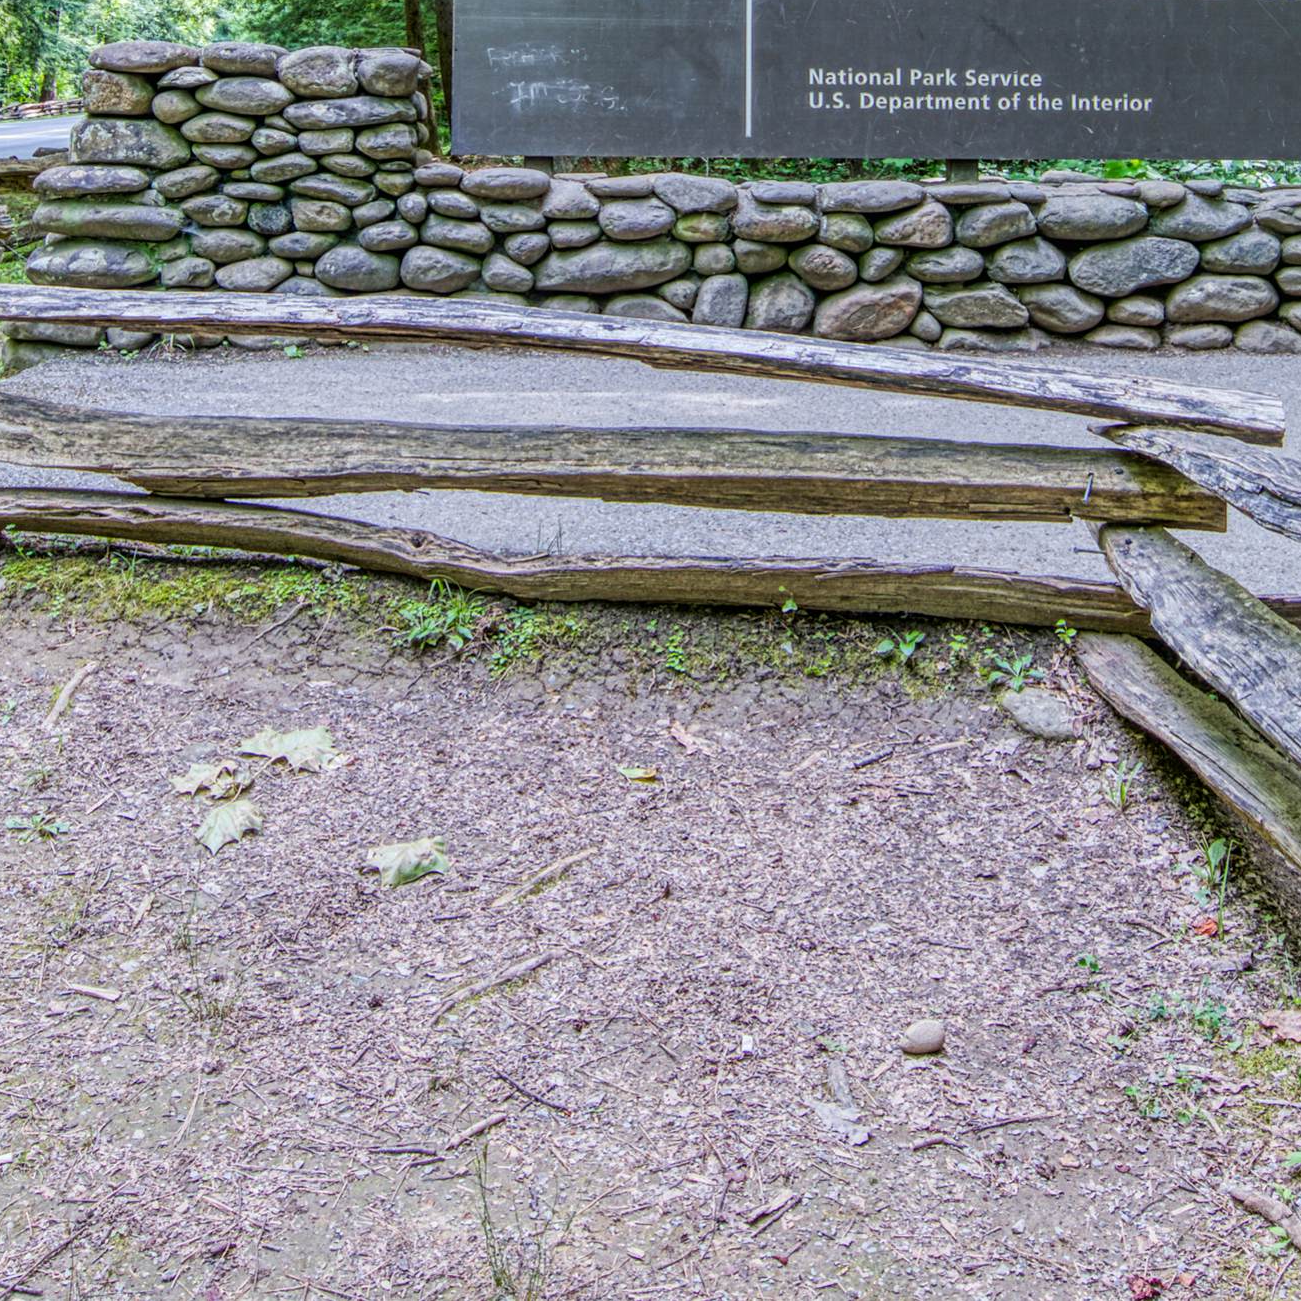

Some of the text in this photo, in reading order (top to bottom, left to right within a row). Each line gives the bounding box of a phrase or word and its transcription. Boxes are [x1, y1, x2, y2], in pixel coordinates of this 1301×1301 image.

[808, 67, 1043, 88] National Park Service
[808, 91, 1153, 115] U.S. Department of the Interior
